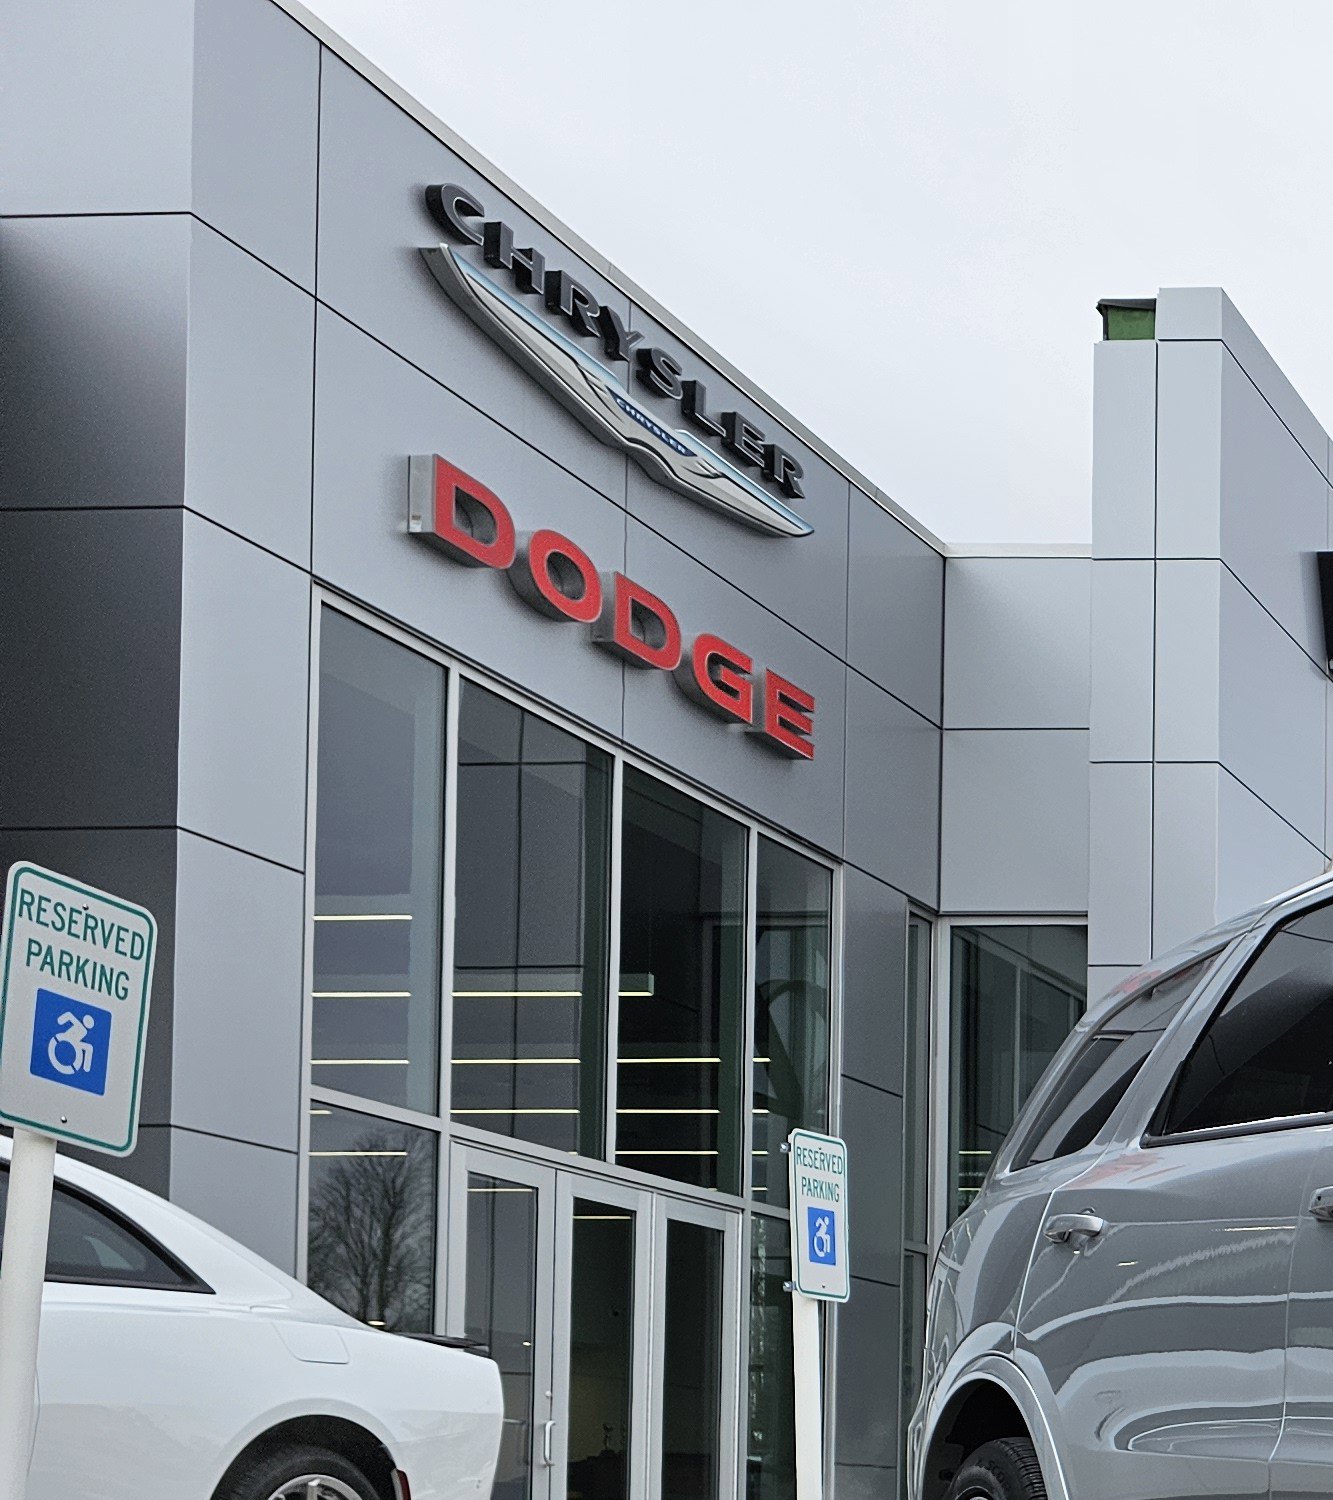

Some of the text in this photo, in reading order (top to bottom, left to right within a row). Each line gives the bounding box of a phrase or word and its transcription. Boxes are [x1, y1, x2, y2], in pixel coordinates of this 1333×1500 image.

[425, 183, 806, 499] CHRYSLER
[408, 453, 815, 760] DODGE
[18, 887, 146, 962] RESERVED
[25, 938, 130, 1001] PARKING
[796, 1146, 843, 1175] RESERVED
[801, 1176, 840, 1203] PARKING
